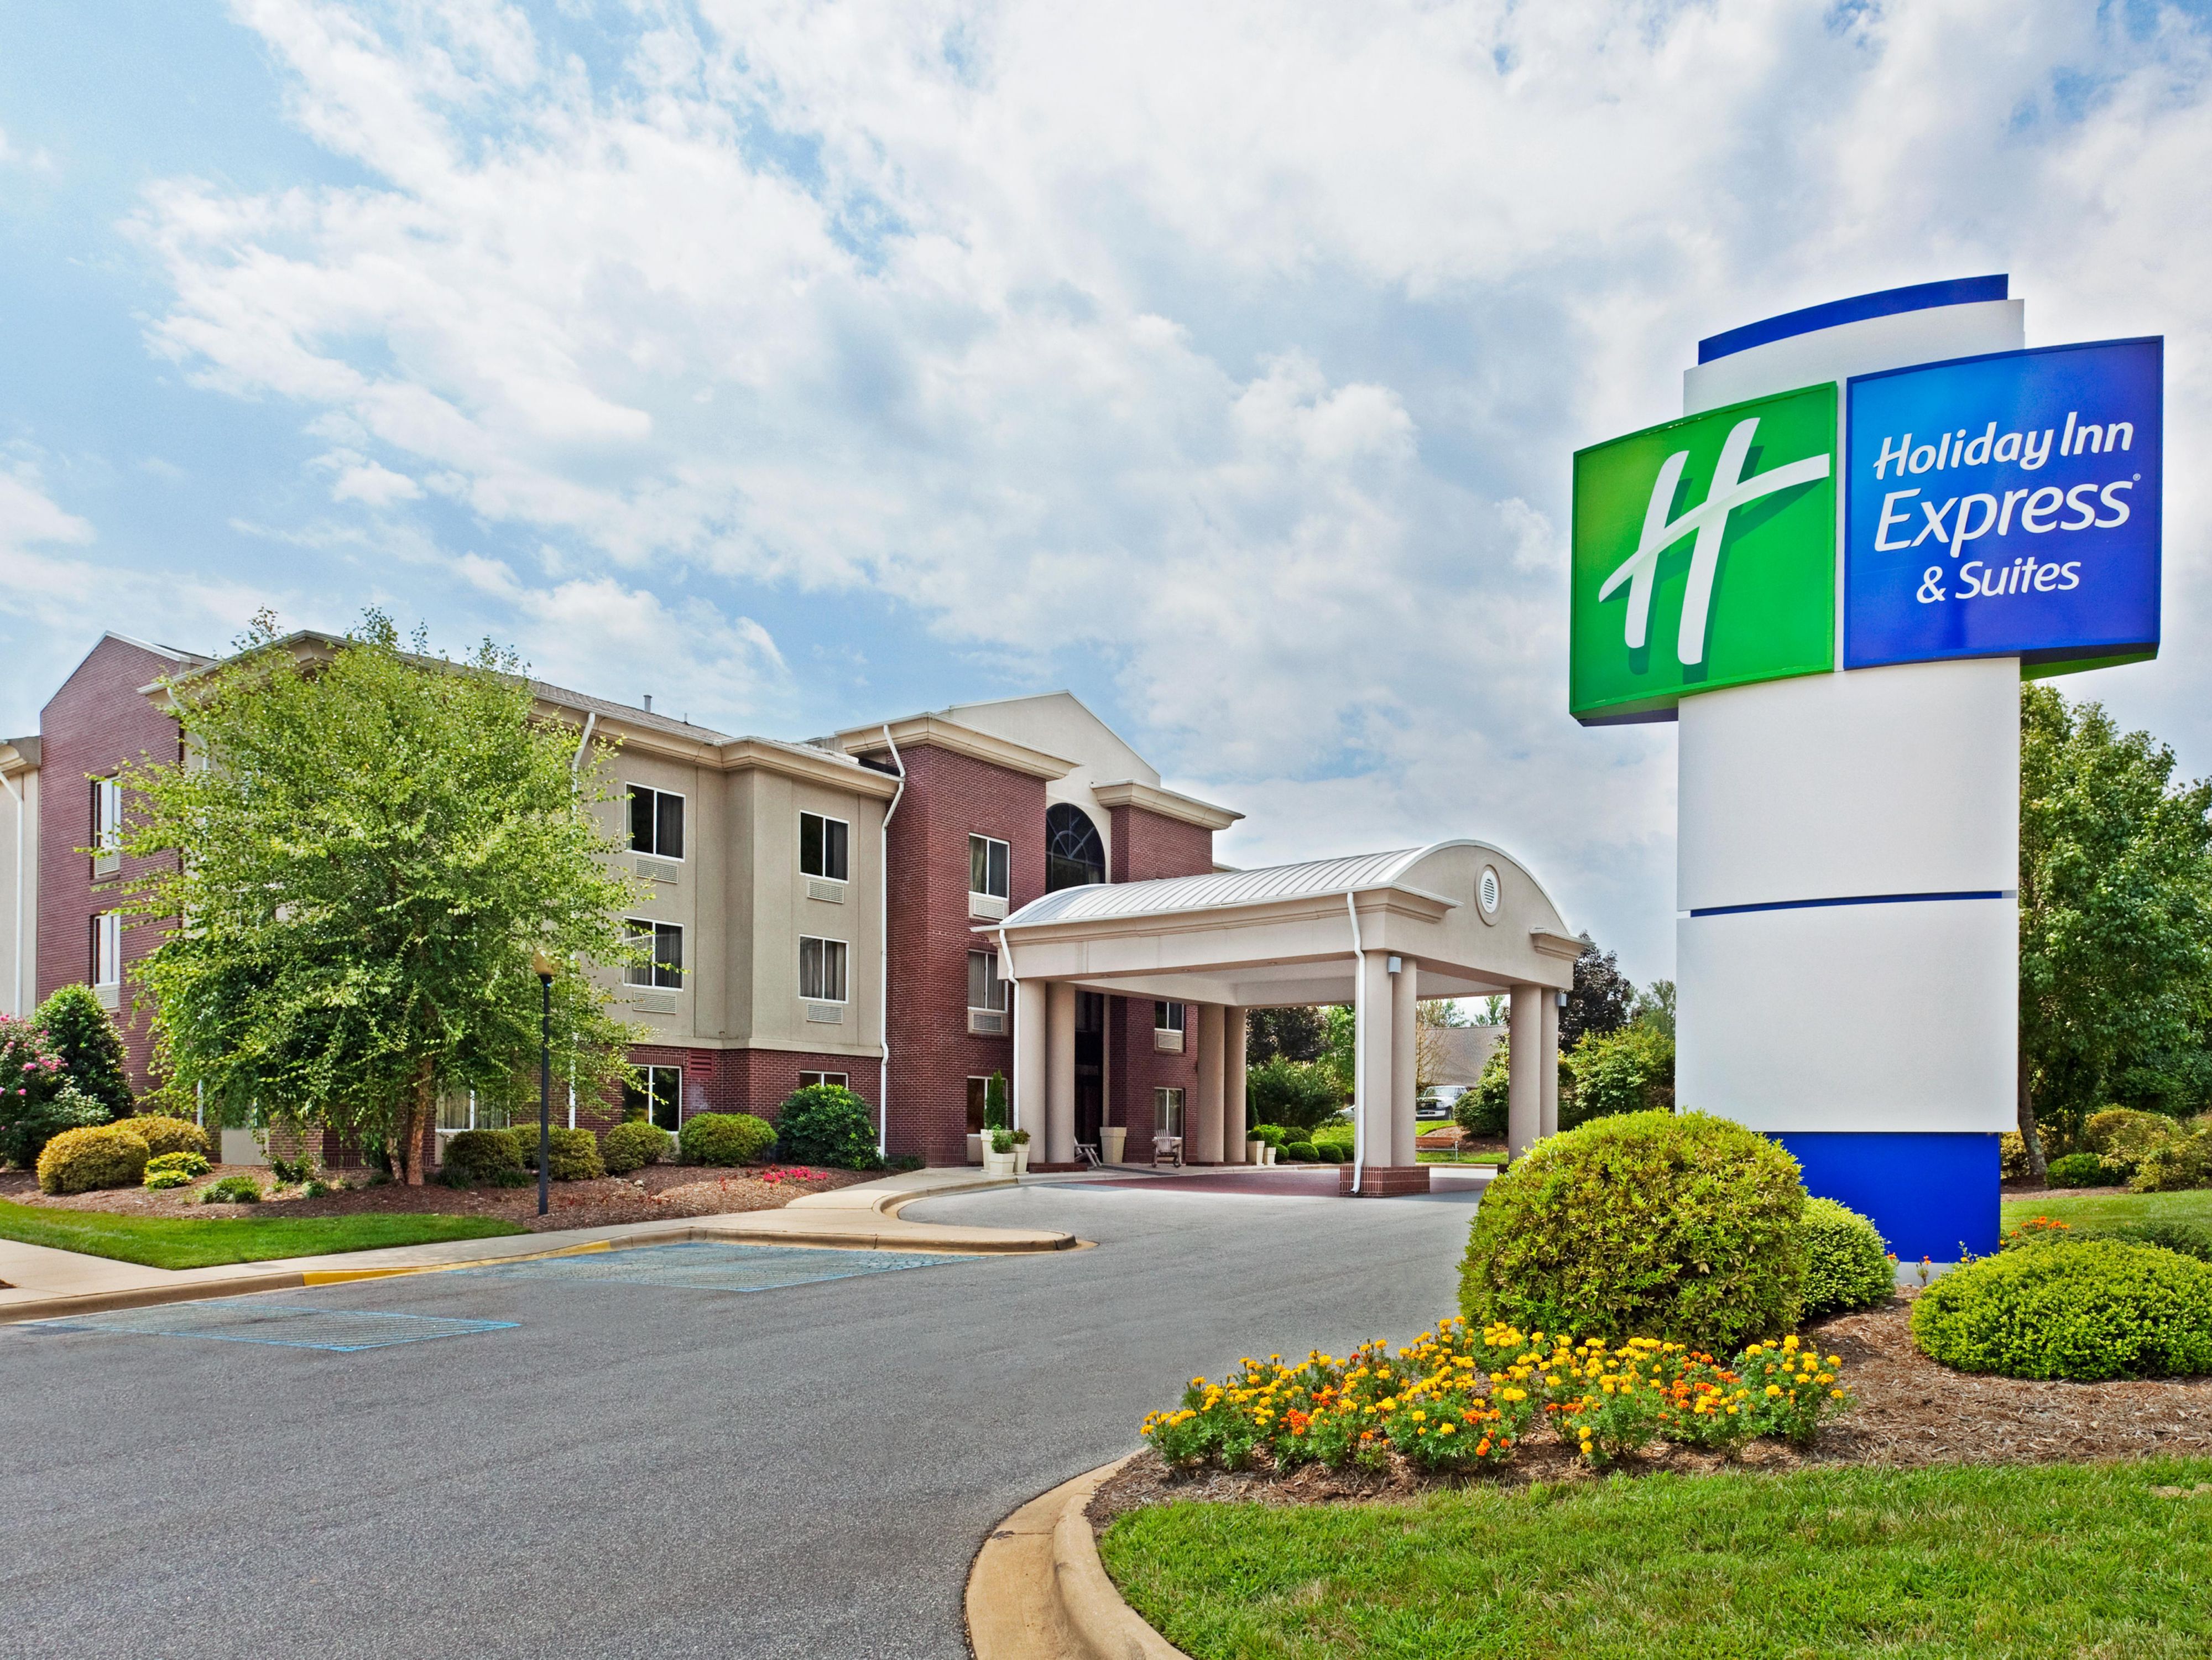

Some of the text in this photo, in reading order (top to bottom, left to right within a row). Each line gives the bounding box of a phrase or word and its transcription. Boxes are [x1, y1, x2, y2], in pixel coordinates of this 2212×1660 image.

[1873, 412, 2133, 480] Holiday Inn
[1916, 556, 2081, 603] & Suites
